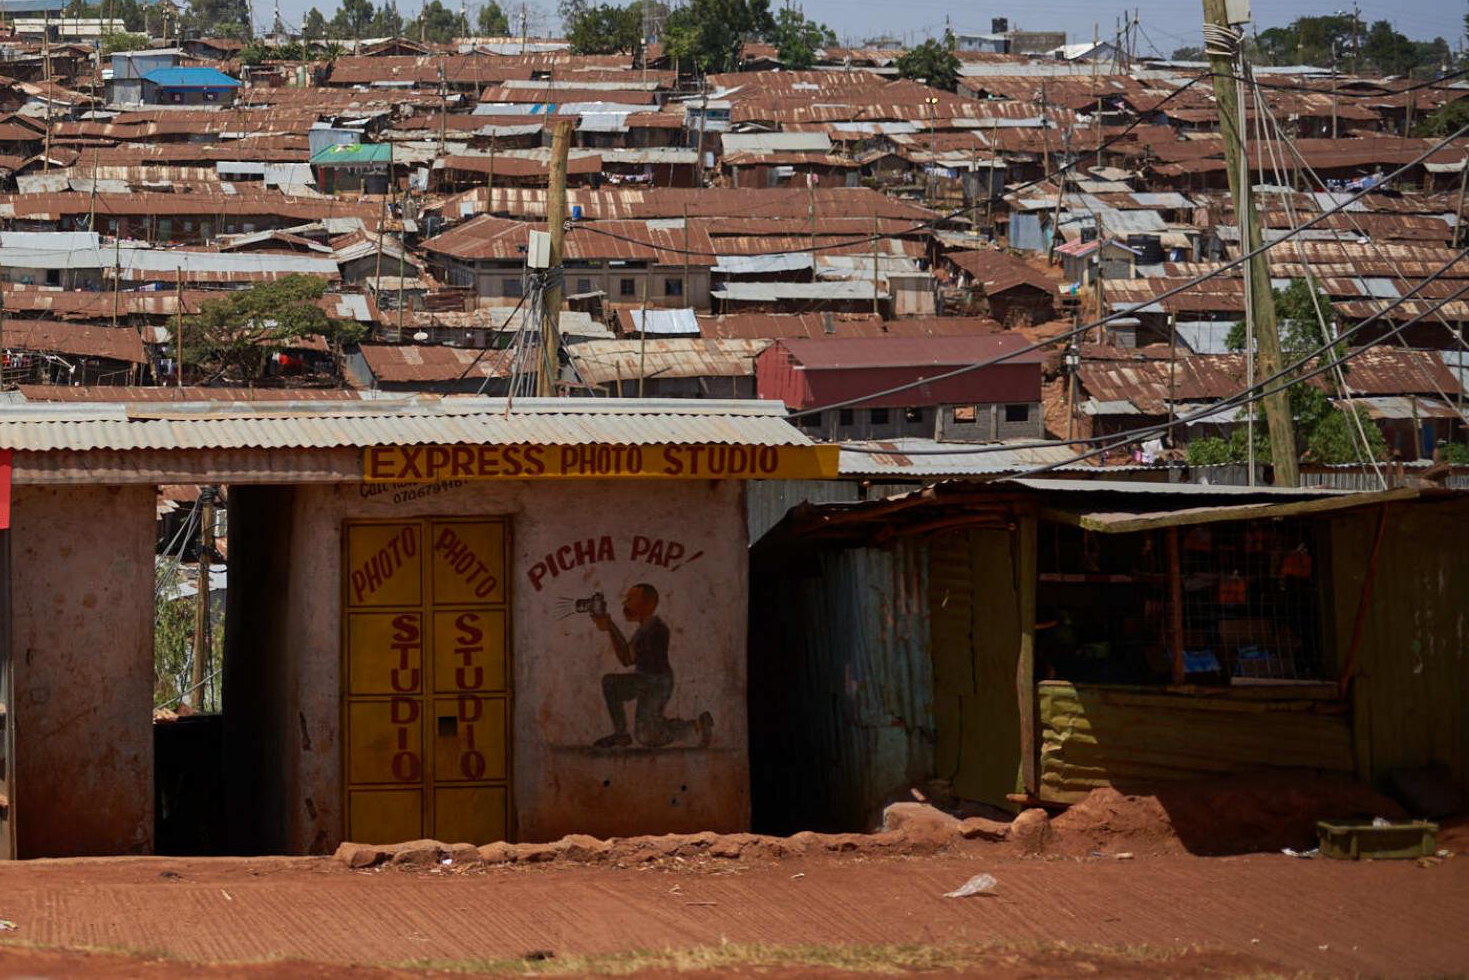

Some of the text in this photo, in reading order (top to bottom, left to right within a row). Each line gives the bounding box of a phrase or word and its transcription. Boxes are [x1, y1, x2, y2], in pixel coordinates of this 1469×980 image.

[371, 445, 778, 479] EXPRESS PHOTO STUDIO
[351, 526, 417, 604] PHOTO
[434, 528, 497, 599] PHOTO
[526, 535, 616, 592] PICHA
[390, 614, 421, 782] STUDIO
[454, 612, 487, 781] STUDIO
